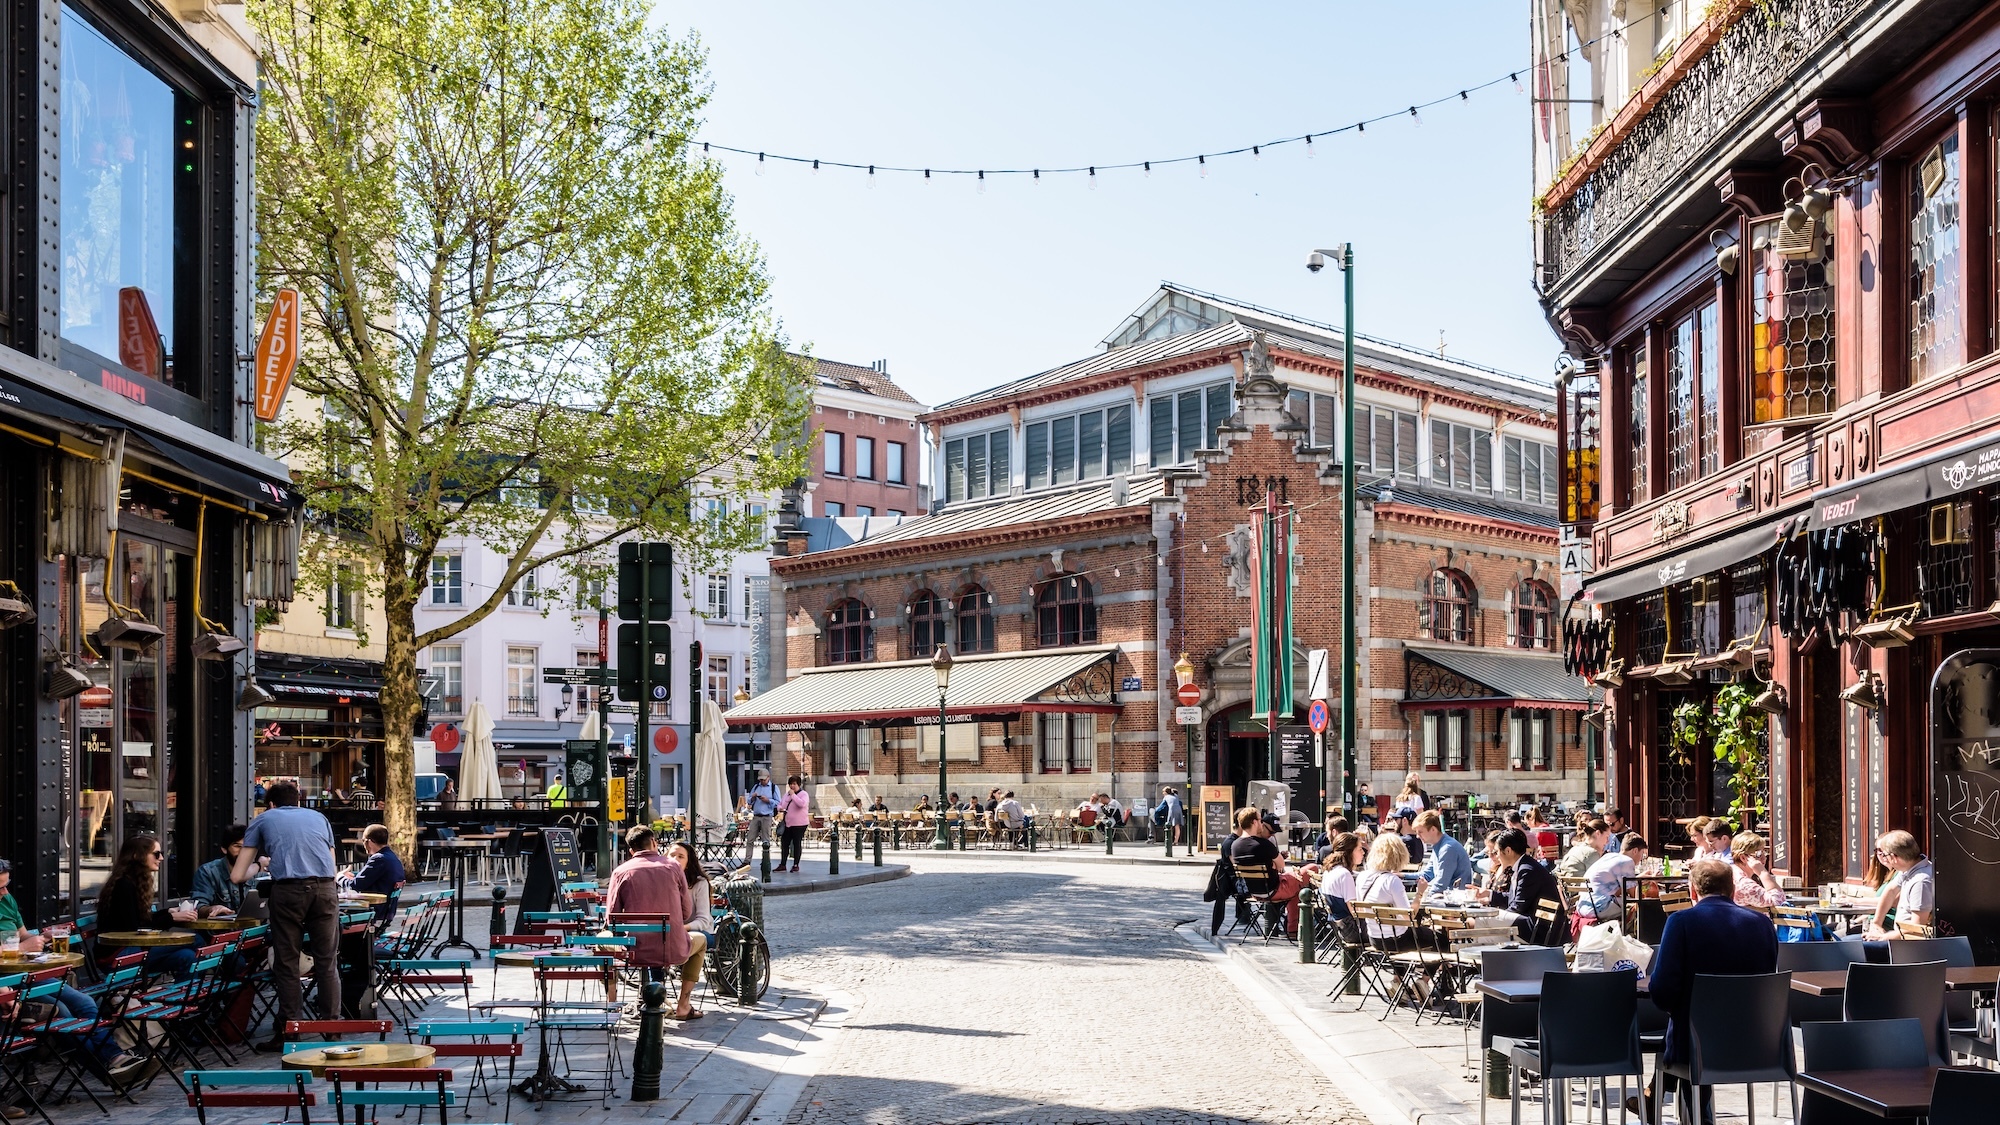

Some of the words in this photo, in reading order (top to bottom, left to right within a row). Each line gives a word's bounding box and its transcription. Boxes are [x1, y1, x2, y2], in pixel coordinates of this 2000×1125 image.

[260, 299, 292, 411] VEDETT
[1790, 460, 1809, 477] LILLET
[1822, 499, 1857, 521] VEDETT
[751, 598, 760, 632] ORLEY
[751, 635, 760, 657] VAN
[751, 656, 759, 693] BERNARD
[782, 722, 798, 730] Sound
[798, 721, 816, 730] District
[932, 715, 952, 724] Sond
[952, 714, 972, 722] District
[87, 742, 100, 752] ROI
